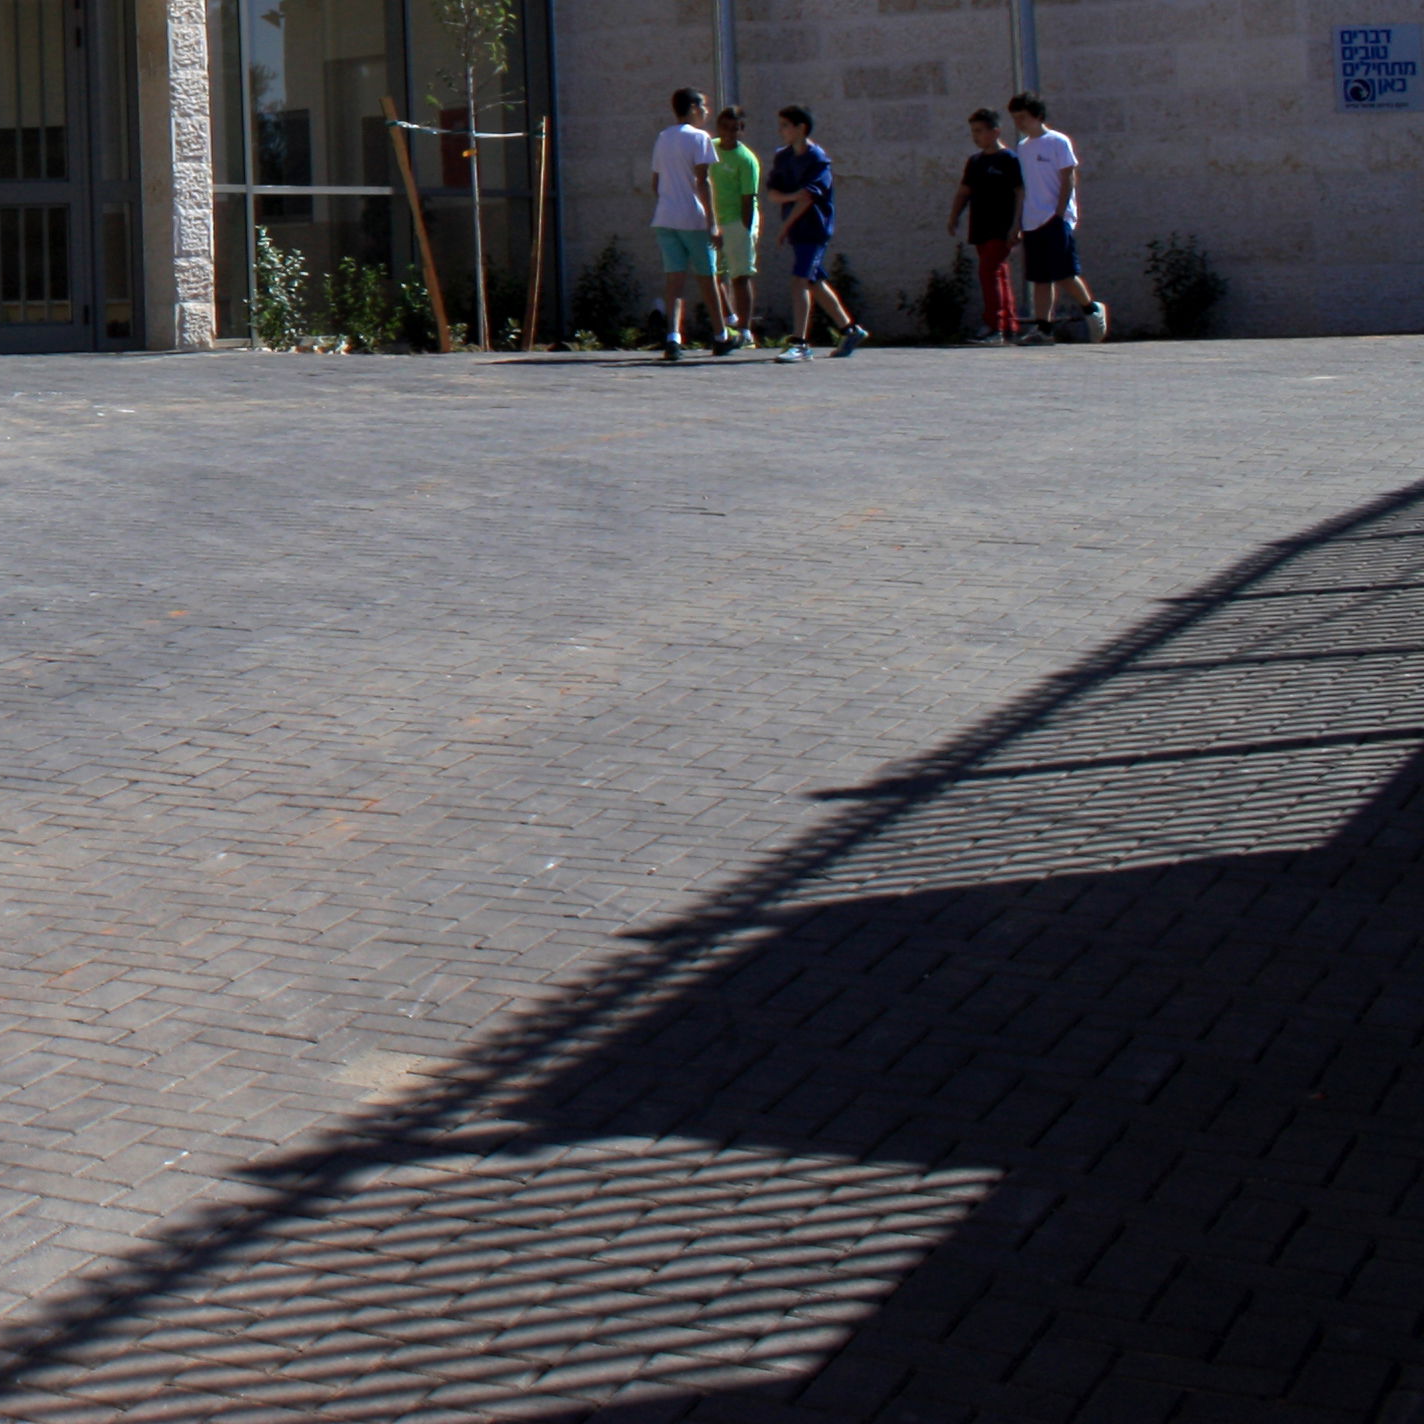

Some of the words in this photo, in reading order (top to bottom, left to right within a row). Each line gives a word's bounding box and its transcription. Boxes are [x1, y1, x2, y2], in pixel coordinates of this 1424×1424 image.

[1340, 29, 1392, 44] דברים
[1341, 45, 1389, 61] טובים
[1342, 61, 1417, 77] מתחילים
[1378, 78, 1407, 95] כאן
